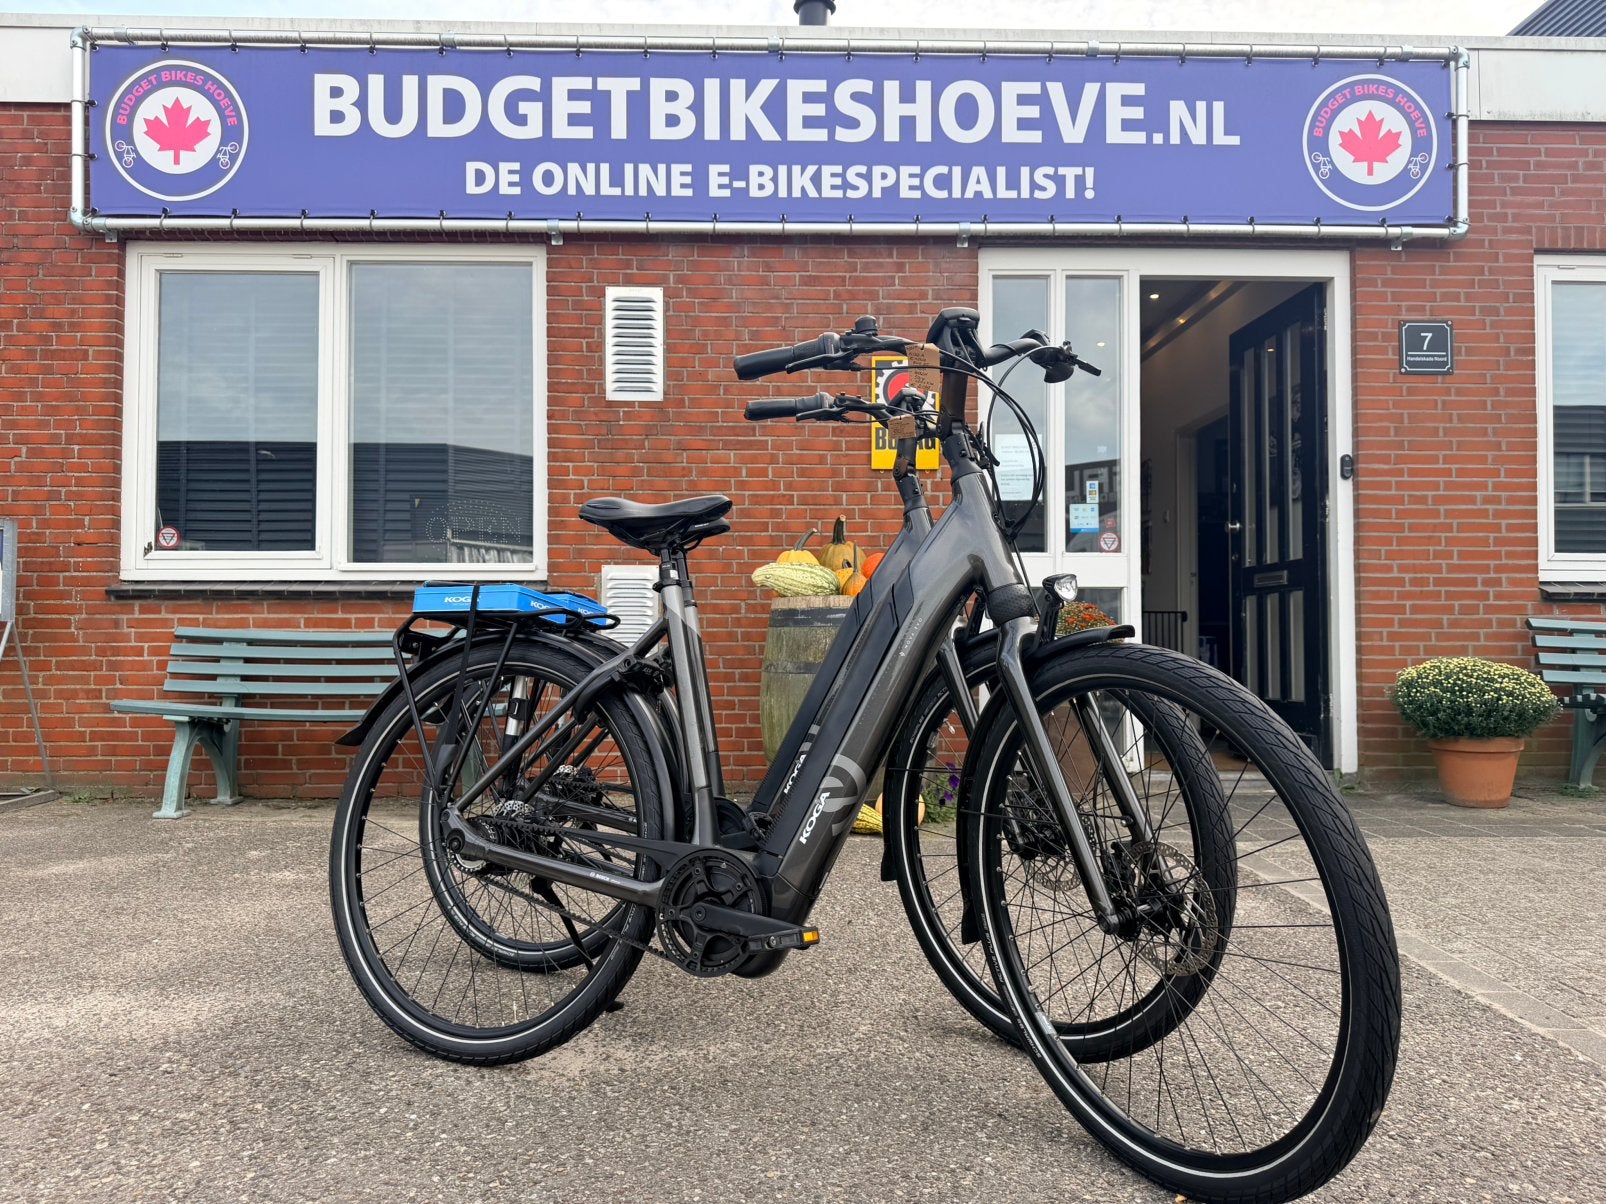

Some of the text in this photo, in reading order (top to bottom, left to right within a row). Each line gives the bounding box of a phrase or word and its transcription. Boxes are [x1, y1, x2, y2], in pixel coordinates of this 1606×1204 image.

[116, 70, 239, 127] BUDGET BIKES HOEVE
[313, 72, 1242, 147] BUDGETBIKESHOEVE.NL
[1313, 84, 1428, 137] BUDGET BIKES HOEVE
[465, 161, 1096, 201] DE ONLINE E-BIKESPECIALIST!
[1420, 332, 1433, 351] 7
[425, 516, 521, 543] OPEN
[799, 792, 831, 845] KOGA
